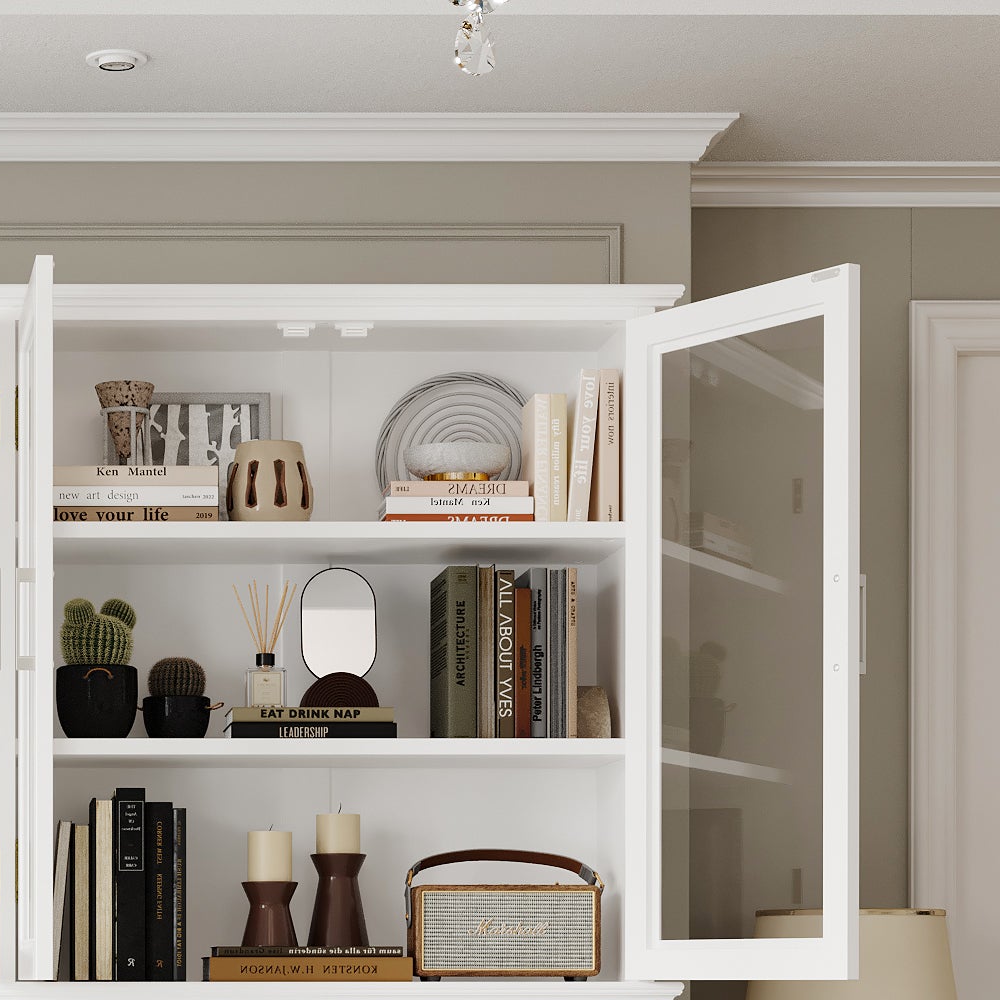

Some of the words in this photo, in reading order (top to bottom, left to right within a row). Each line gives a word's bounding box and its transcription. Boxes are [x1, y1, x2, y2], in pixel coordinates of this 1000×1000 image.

[96, 467, 118, 476] Ken
[128, 467, 167, 476] Mantel
[86, 492, 100, 500] art
[107, 490, 139, 502] design
[54, 508, 88, 520] love
[96, 510, 134, 521] your
[143, 507, 169, 521] life
[500, 578, 512, 608] ALL
[456, 600, 466, 686] ARCHITECTURE
[500, 613, 512, 670] ABOUT
[532, 644, 544, 694] Lindbergh
[500, 677, 512, 718] YVES
[532, 696, 542, 722] Peter
[260, 709, 284, 718] EAT
[290, 709, 330, 718] DRINK
[334, 709, 360, 718] NAP
[280, 726, 328, 738] LEADERSHIP
